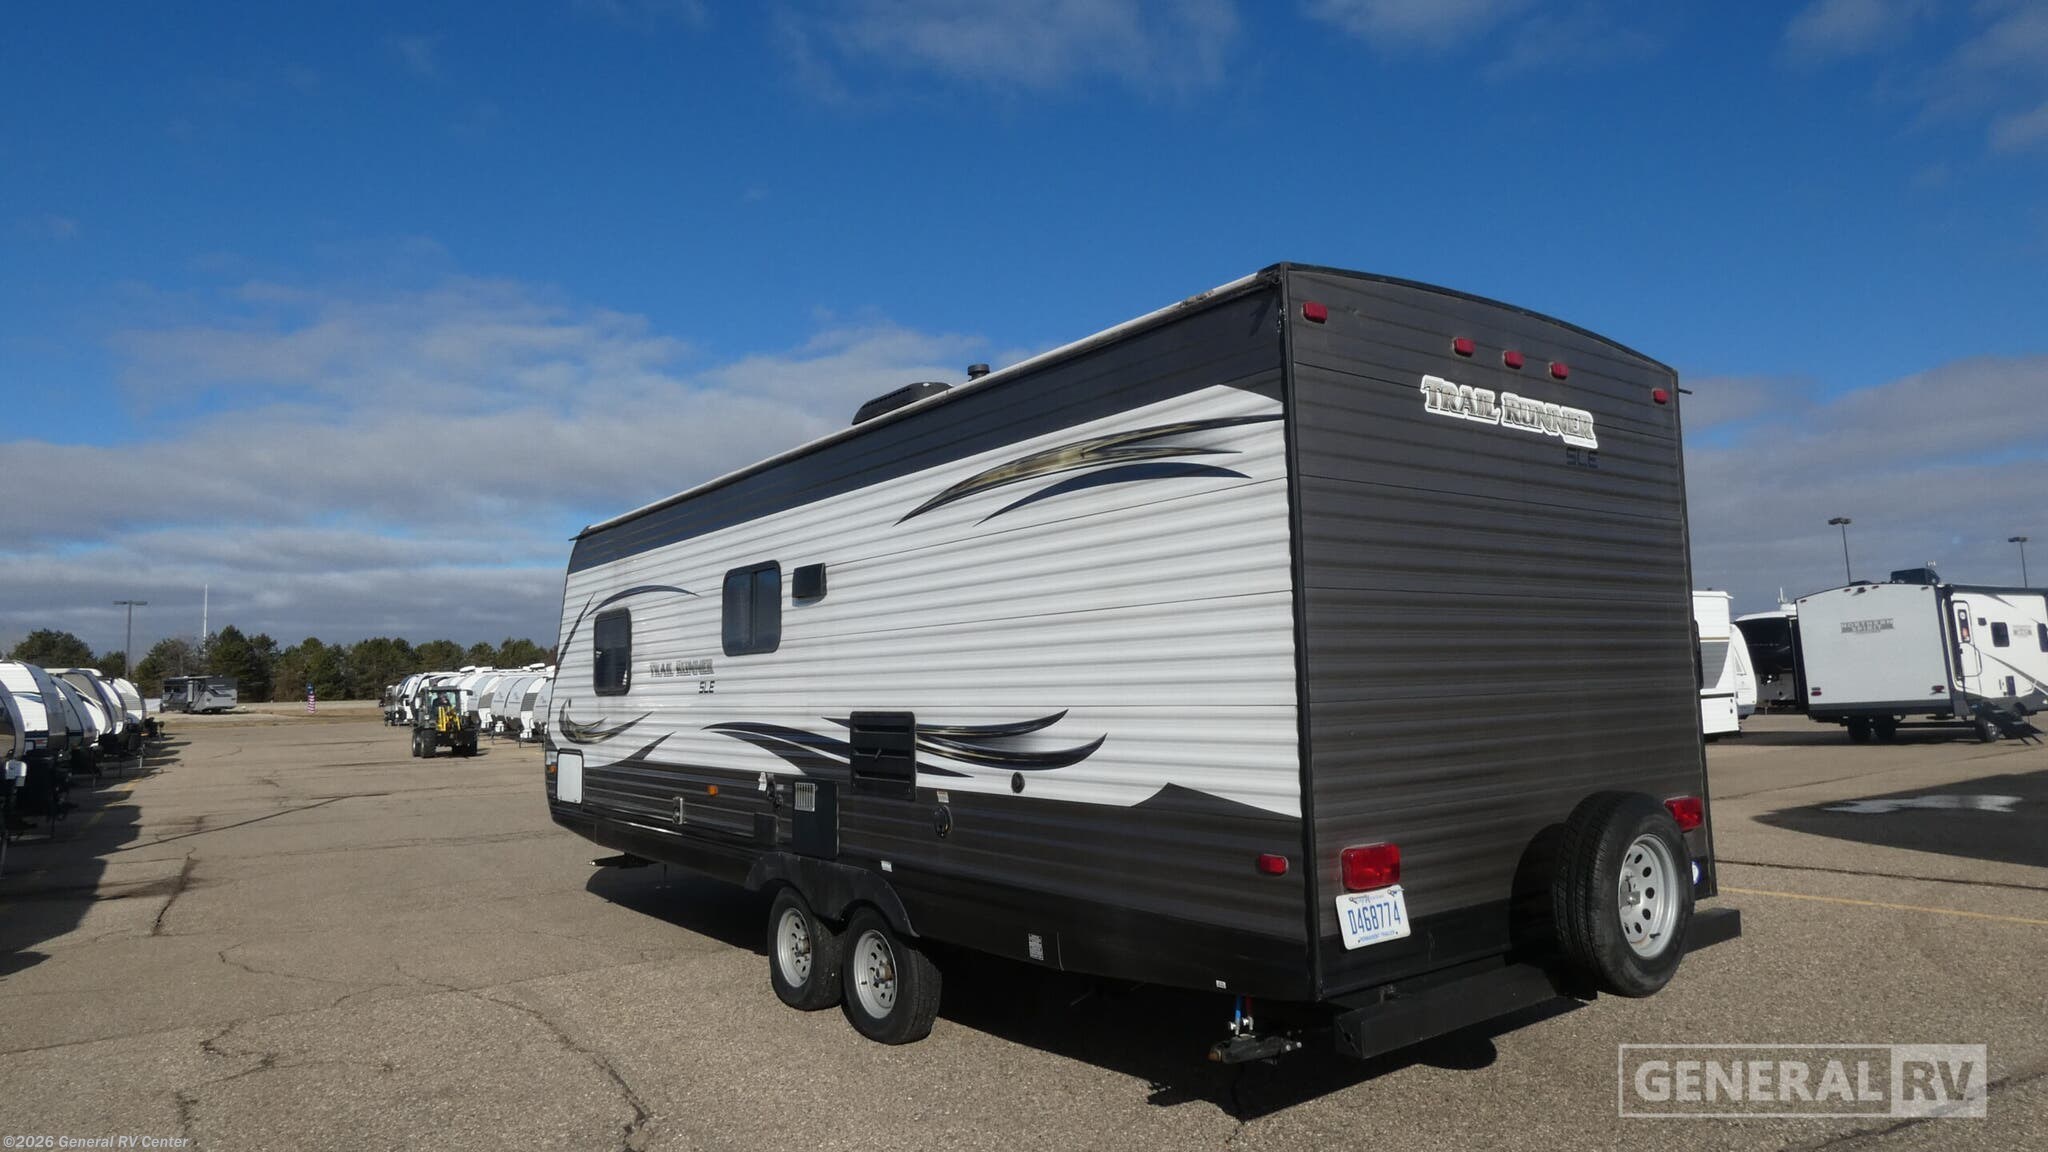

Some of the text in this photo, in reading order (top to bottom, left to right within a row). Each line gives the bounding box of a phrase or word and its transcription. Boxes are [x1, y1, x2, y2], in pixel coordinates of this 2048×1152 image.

[1421, 376, 1597, 447] TRAIL RUNNER
[1566, 450, 1598, 468] SLE
[699, 680, 715, 694] SLE
[1347, 900, 1401, 935] D468774
